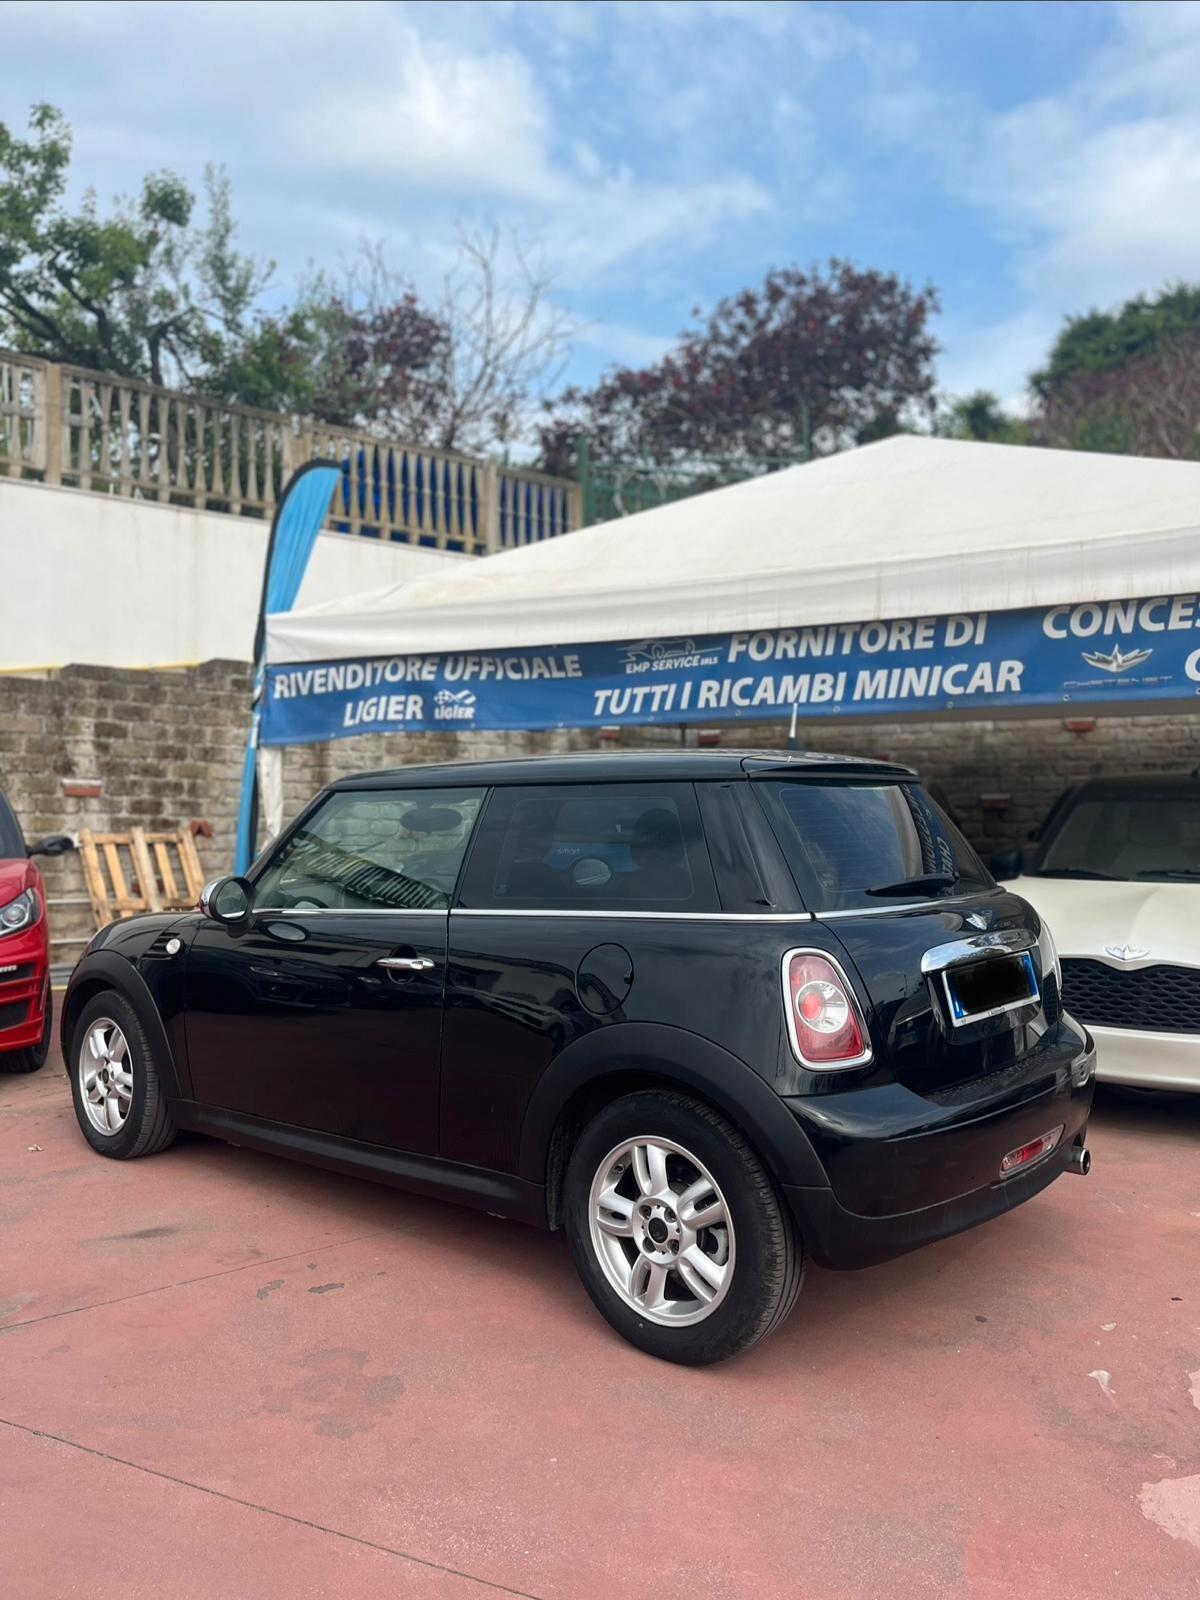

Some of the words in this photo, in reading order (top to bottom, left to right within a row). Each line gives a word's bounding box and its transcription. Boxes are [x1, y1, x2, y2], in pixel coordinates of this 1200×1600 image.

[727, 618, 935, 663] FORNITORE
[944, 613, 989, 648] DI
[273, 656, 439, 699] RIVENDITORE
[445, 655, 582, 681] UFFICIALE
[652, 655, 700, 671] SERVICE
[593, 684, 677, 716] TUTTI
[697, 672, 847, 709] RICAMBI
[852, 660, 1024, 701] MINICAR
[343, 695, 423, 727] LIGIER
